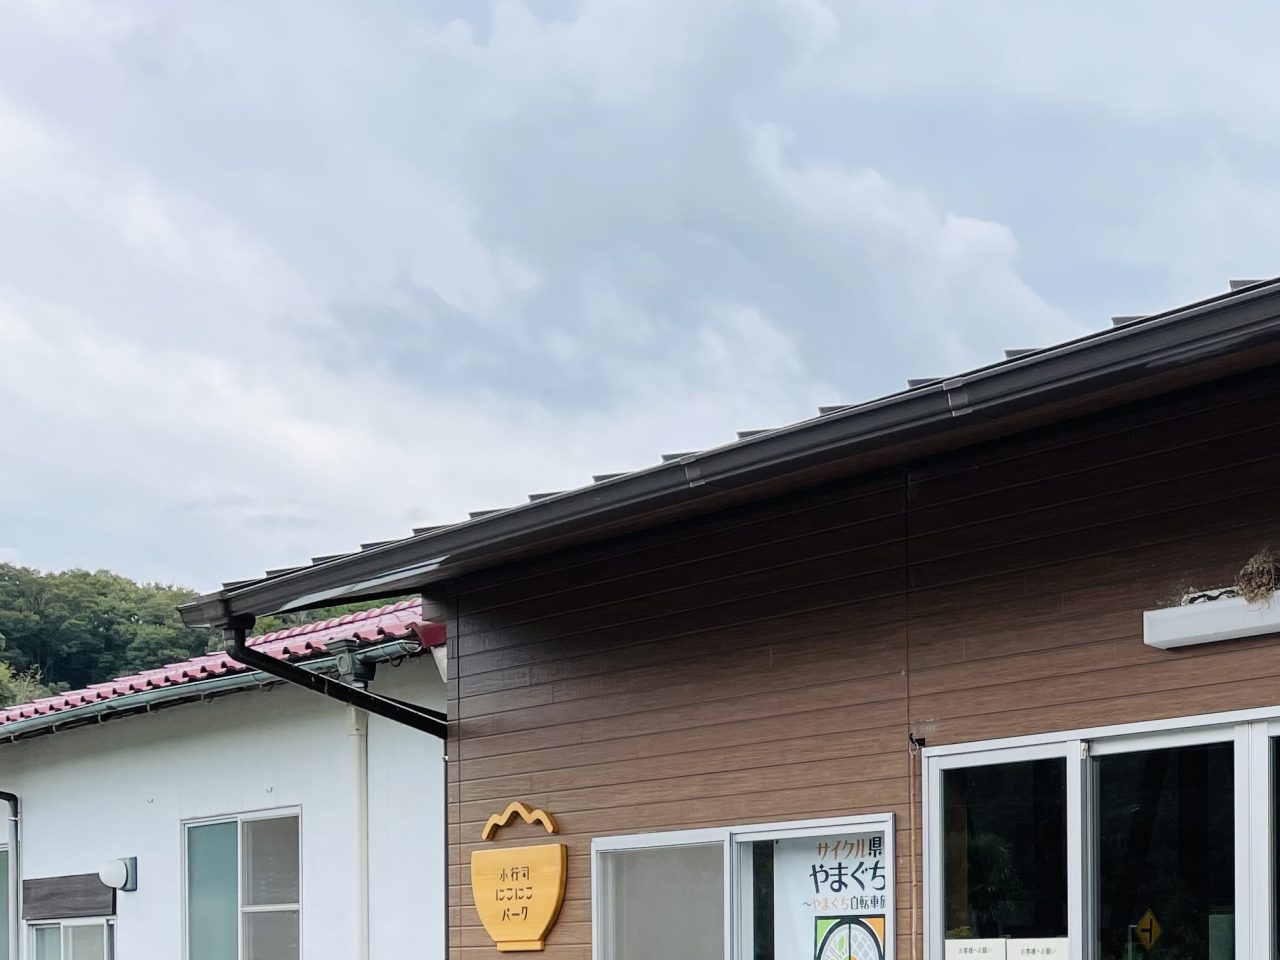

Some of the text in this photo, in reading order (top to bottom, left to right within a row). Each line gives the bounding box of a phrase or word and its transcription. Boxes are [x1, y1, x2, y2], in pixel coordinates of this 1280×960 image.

[816, 836, 882, 860] サイクル県
[499, 866, 530, 882] 小行司
[809, 860, 885, 894] やまぐち
[495, 886, 533, 901] にこにこ
[501, 906, 528, 922] パーク
